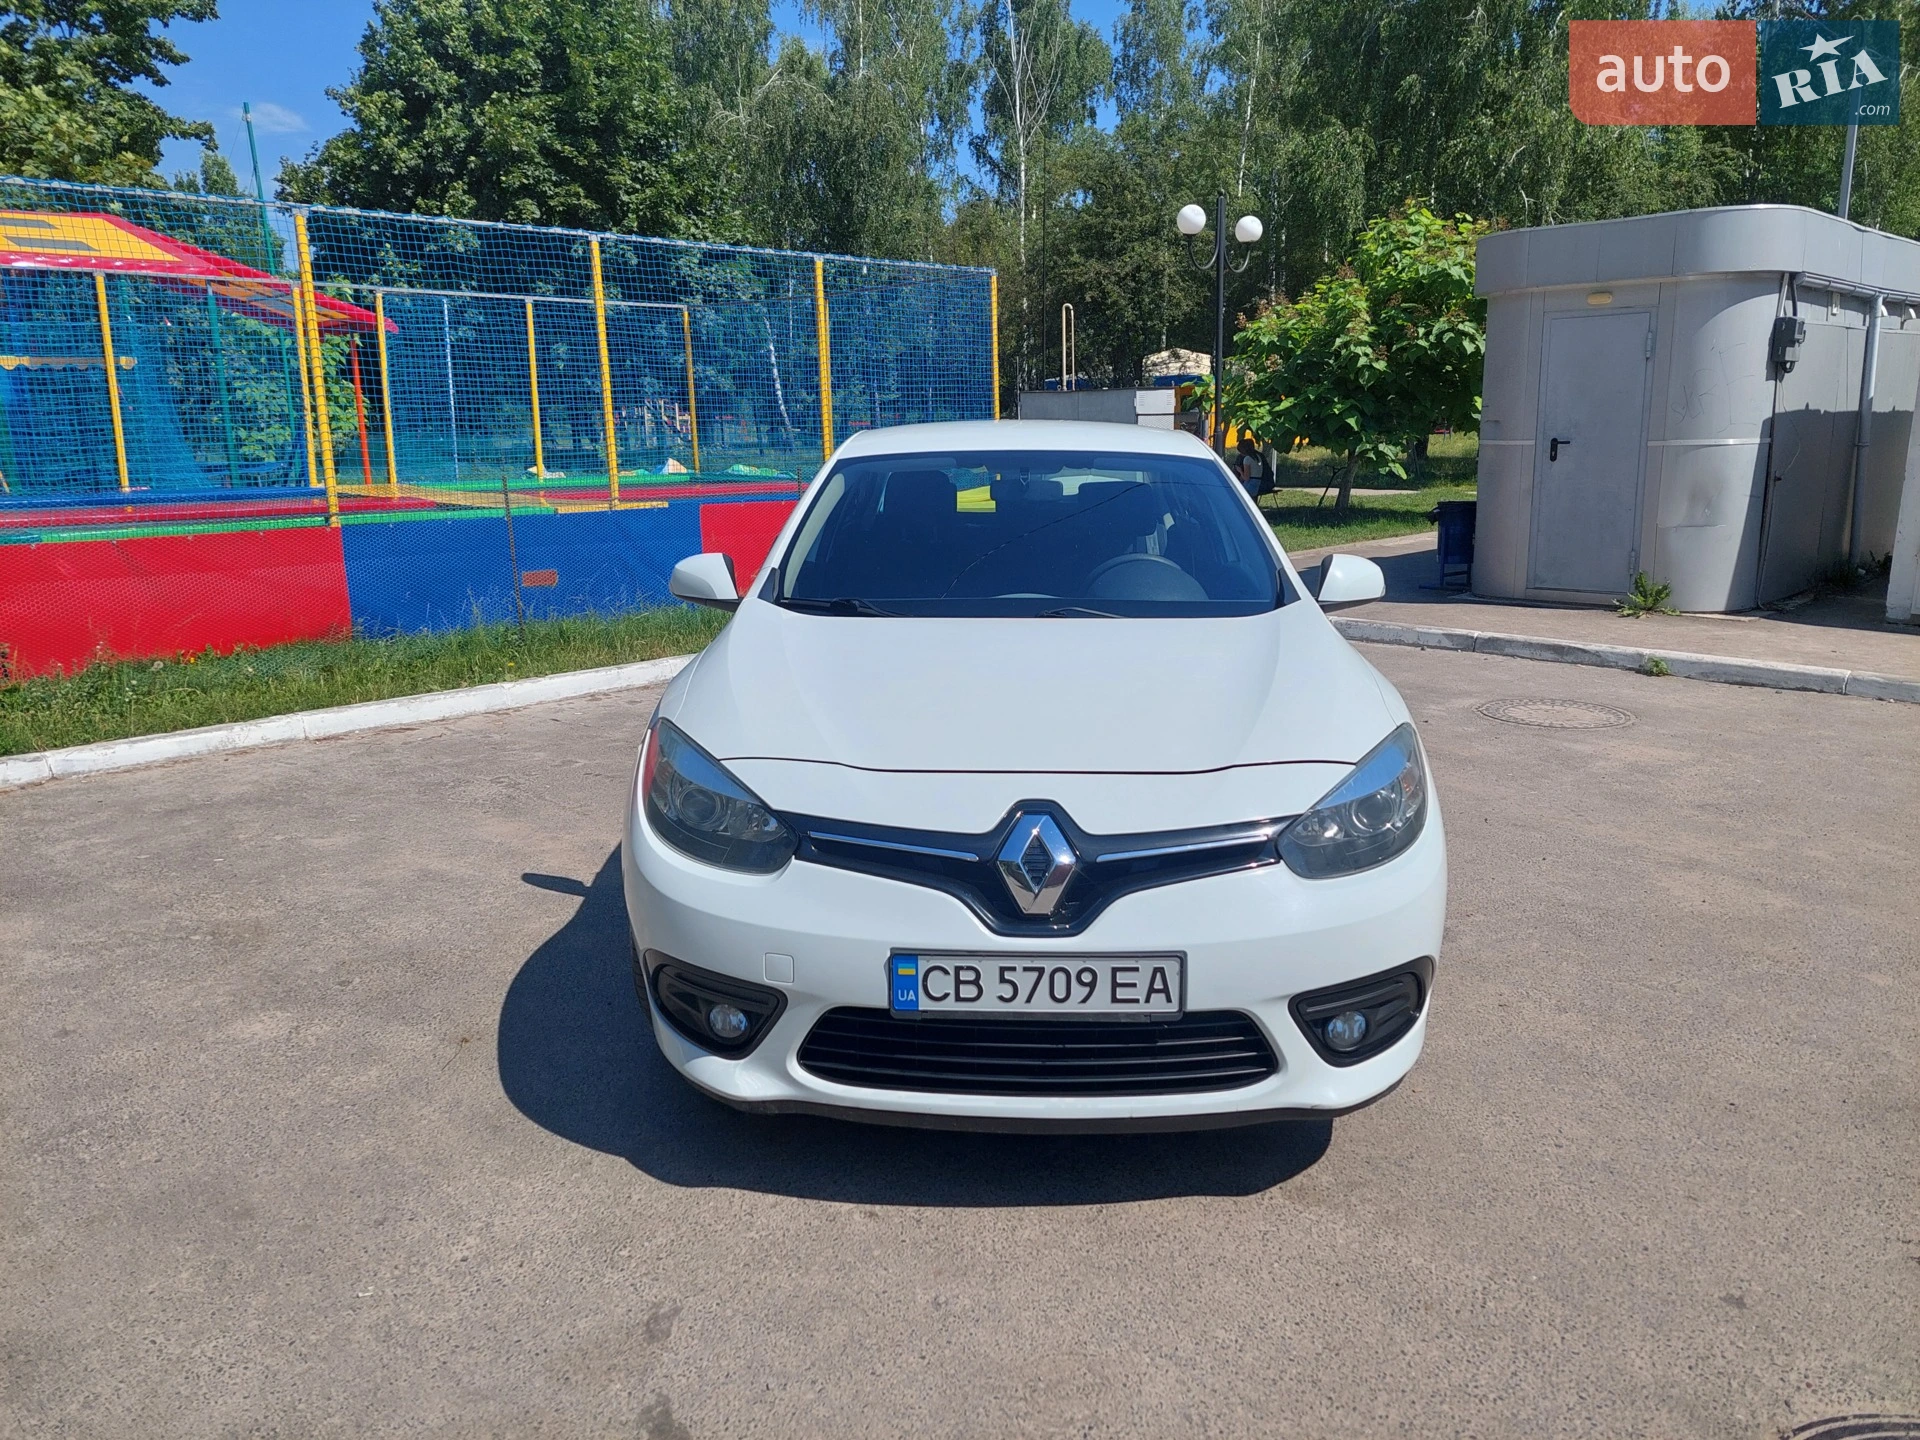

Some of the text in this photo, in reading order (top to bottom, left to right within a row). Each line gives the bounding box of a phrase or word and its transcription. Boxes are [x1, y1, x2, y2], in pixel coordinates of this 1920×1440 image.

[898, 989, 916, 1001] UA
[922, 965, 1173, 1004] CB 5709 EA
